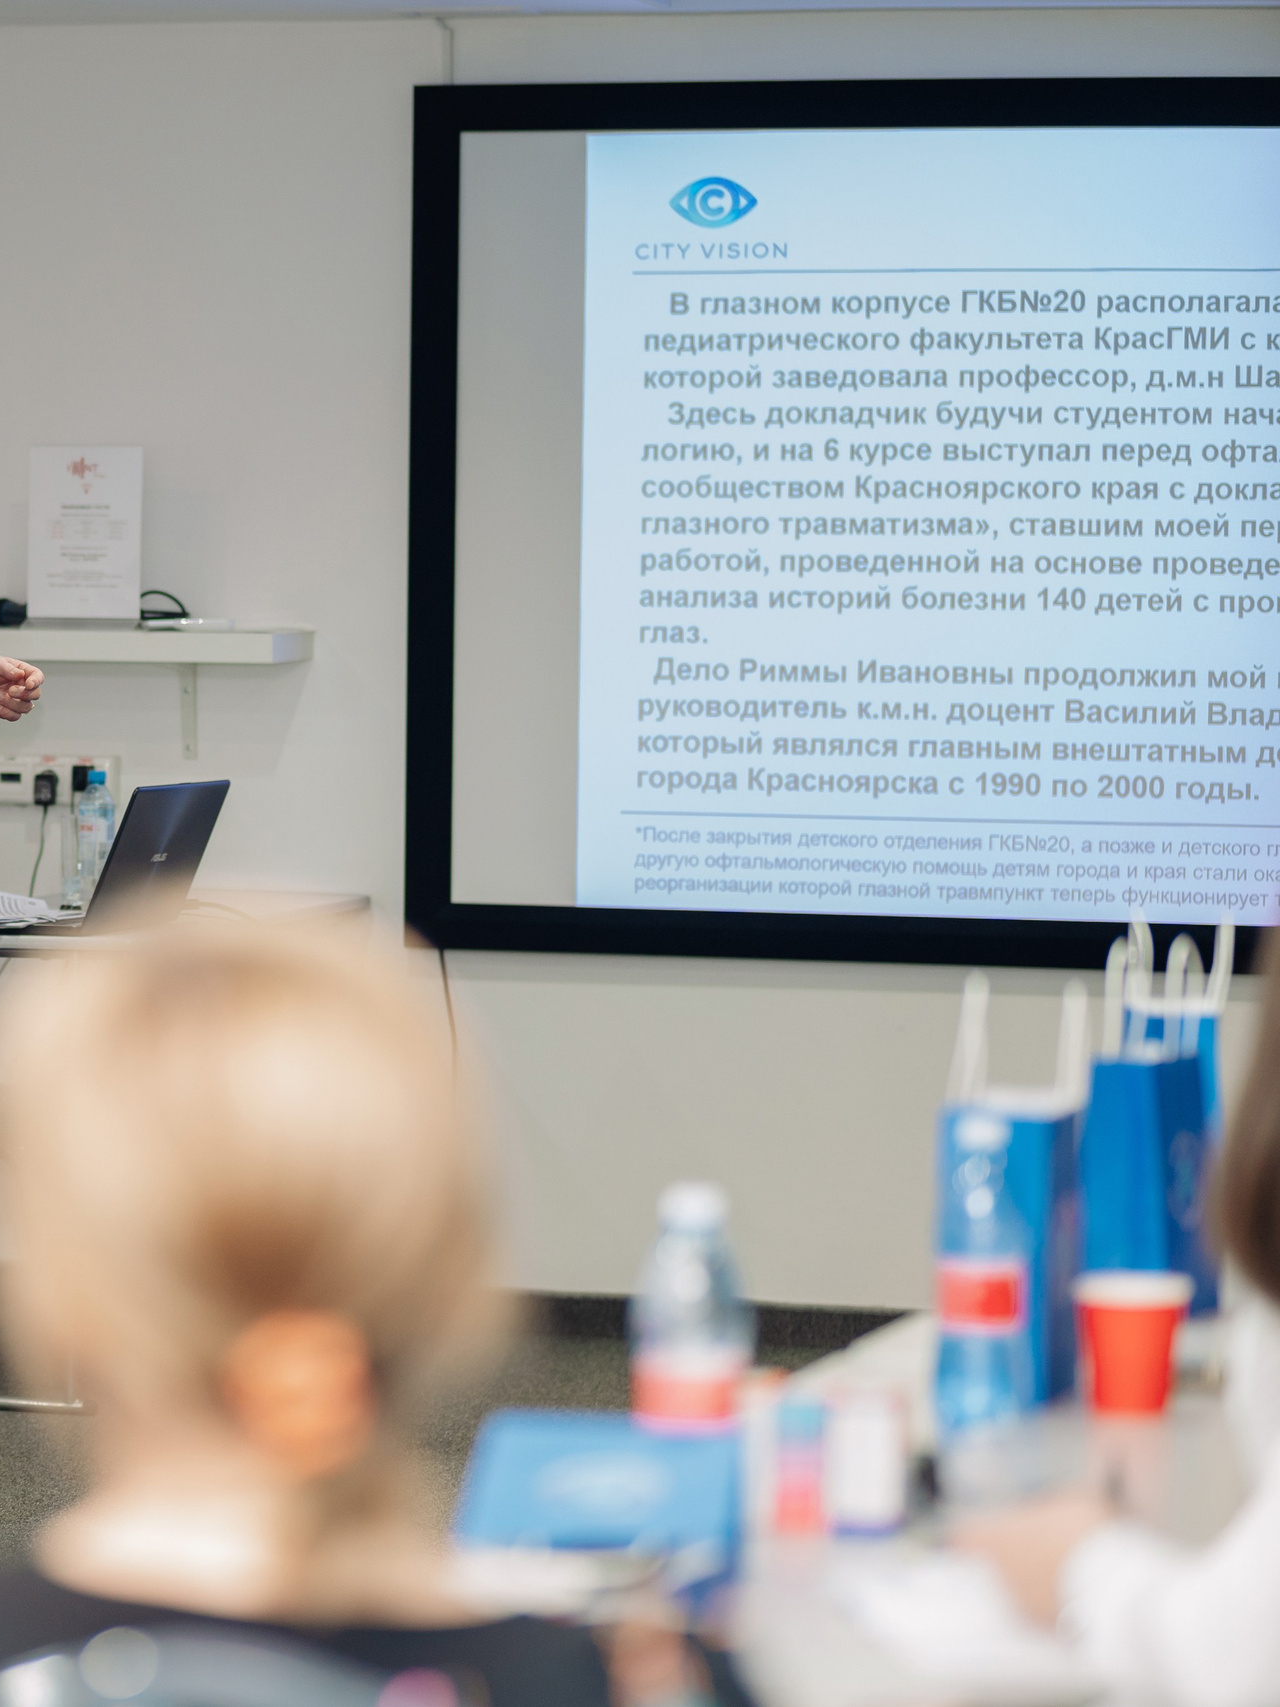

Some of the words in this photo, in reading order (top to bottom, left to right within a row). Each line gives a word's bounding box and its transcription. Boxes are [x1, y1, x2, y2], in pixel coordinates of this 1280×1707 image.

[634, 243, 691, 261] CITY
[700, 242, 788, 260] VISION
[669, 291, 690, 316] В
[700, 296, 821, 315] глазном
[831, 294, 951, 320] корпусе
[961, 288, 1086, 314] ГКБ№20
[644, 332, 900, 357] педиатрического
[909, 326, 1084, 357] факультета
[1094, 325, 1230, 356] КрасГМИ
[1240, 331, 1256, 351] с
[643, 364, 762, 395] которой
[772, 368, 948, 393] заведовала
[958, 363, 1137, 394] профессор,
[1145, 369, 1224, 393] д.м.н
[1235, 364, 1280, 389] Ша
[667, 401, 756, 430] Здесь
[763, 405, 927, 429] докладчик
[935, 400, 1043, 431] будучи
[1053, 405, 1213, 431] студентом
[1223, 406, 1280, 426] нач
[641, 442, 743, 466] логию,
[753, 443, 770, 461] и
[780, 442, 814, 462] на
[823, 437, 840, 462] 6
[849, 442, 932, 467] курсе
[942, 442, 1091, 468] выступал
[1101, 442, 1193, 468] перед
[1201, 438, 1280, 469] офта
[641, 474, 845, 503] сообществом
[855, 474, 1081, 506] Красноярского
[1091, 480, 1159, 506] края
[1169, 481, 1186, 501] с
[641, 516, 770, 535] глазного
[778, 516, 999, 541] травматизма»,
[1009, 517, 1143, 538] ставшим
[1154, 512, 1230, 538] моей
[1240, 519, 1280, 544] пе
[640, 547, 769, 577] работой,
[779, 549, 980, 579] проведенной
[990, 555, 1024, 574] на
[1034, 555, 1143, 575] основе
[1152, 556, 1280, 581] проведе
[639, 589, 758, 609] анализа
[768, 585, 891, 615] историй
[901, 585, 1026, 611] болезни
[1037, 586, 1086, 611] 140
[1094, 587, 1183, 616] детей
[1193, 593, 1209, 613] с
[1219, 594, 1280, 619] про
[639, 625, 708, 644] глаз.
[653, 657, 730, 686] Дело
[739, 658, 847, 683] Риммы
[857, 659, 1013, 685] Ивановны
[1024, 667, 1196, 692] продолжил
[1207, 664, 1266, 689] мой
[638, 698, 847, 722] руководитель
[857, 701, 937, 721] к.м.н.
[945, 702, 1055, 726] доцент
[1064, 698, 1196, 725] Василий
[637, 731, 763, 759] который
[773, 737, 898, 757] являлся
[908, 739, 1041, 760] главным
[1052, 742, 1247, 764] внештатным
[1255, 746, 1280, 768] д
[637, 770, 737, 794] города
[747, 767, 938, 799] Красноярска
[948, 776, 964, 795] с
[975, 772, 1041, 797] 1990
[1052, 779, 1088, 798] по
[1097, 774, 1165, 799] 2000
[1175, 781, 1260, 805] годы.
[706, 830, 793, 849] закрытия
[796, 832, 879, 850] детского
[883, 834, 983, 853] отделения
[988, 833, 1075, 856] ГКБ№20,
[1080, 839, 1093, 854] а
[1098, 839, 1156, 855] позже
[1161, 840, 1173, 855] и
[1177, 840, 1261, 859] детского
[633, 853, 700, 872] другую
[704, 852, 908, 878] офтальмологическую
[912, 860, 988, 879] помощь
[991, 862, 1051, 880] детям
[1056, 863, 1121, 883] города
[1126, 864, 1138, 880] и
[1144, 865, 1187, 884] края
[1192, 866, 1248, 882] стали
[634, 877, 773, 896] реорганизации
[778, 879, 852, 900] которой
[857, 881, 931, 900] глазной
[936, 885, 1045, 906] травмпункт
[1049, 887, 1116, 908] теперь
[1121, 885, 1270, 912] функционирует
